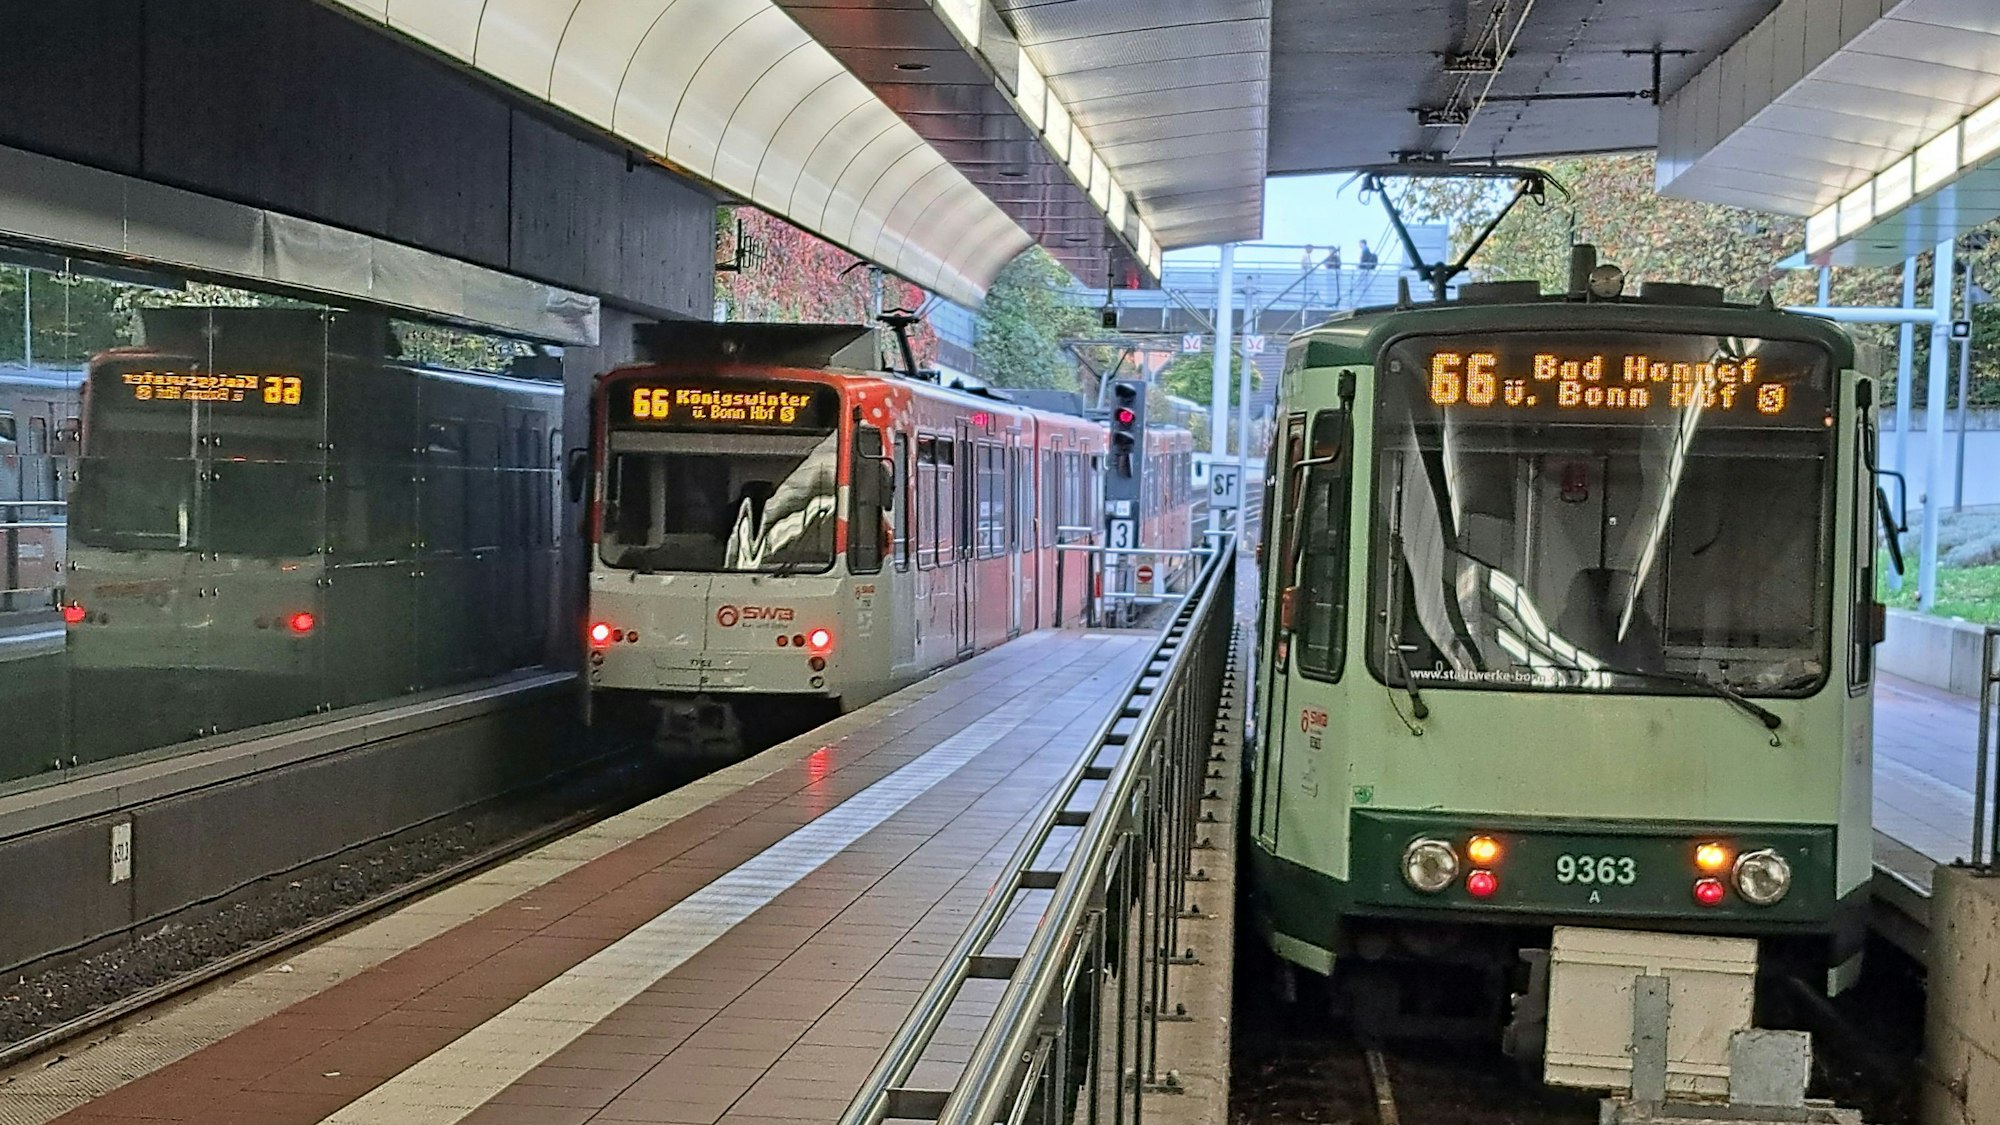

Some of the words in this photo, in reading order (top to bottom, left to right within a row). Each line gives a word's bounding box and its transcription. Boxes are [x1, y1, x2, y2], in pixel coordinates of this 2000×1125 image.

[1430, 353, 1496, 405] 66
[1534, 354, 1601, 380] Bad
[1624, 355, 1757, 382] Honnef
[633, 388, 669, 418] 66
[676, 389, 811, 407] Königswinter
[1504, 379, 1537, 406] ü.
[1559, 380, 1648, 407] Bonn
[1670, 382, 1737, 408] Hbf
[711, 406, 745, 419] Bonn
[750, 405, 775, 420] Hbf
[1213, 473, 1237, 496] SF
[1115, 522, 1128, 548] 3
[742, 606, 794, 621] SWB
[1556, 855, 1636, 885] 9363
[1588, 889, 1601, 904] A
